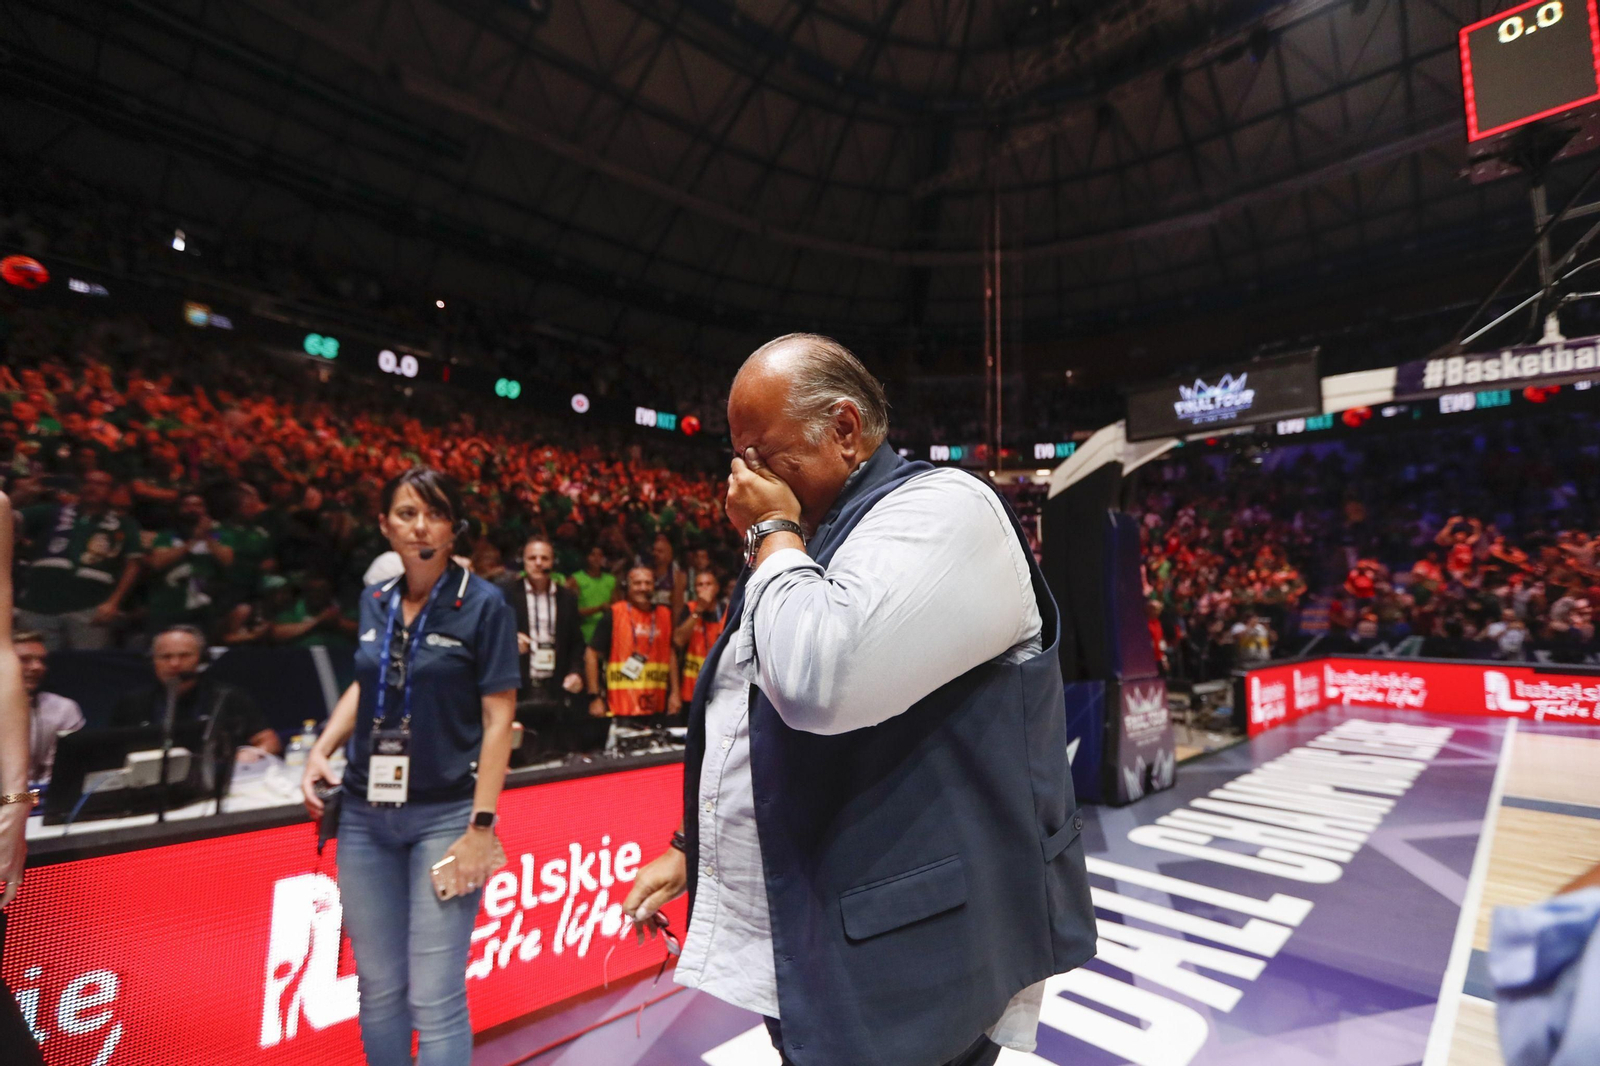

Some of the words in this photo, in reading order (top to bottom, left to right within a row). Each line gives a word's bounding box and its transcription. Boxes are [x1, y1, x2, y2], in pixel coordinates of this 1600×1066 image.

[1498, 1, 1564, 43] 0.0
[378, 350, 418, 378] 0.0
[484, 834, 642, 918] elskie
